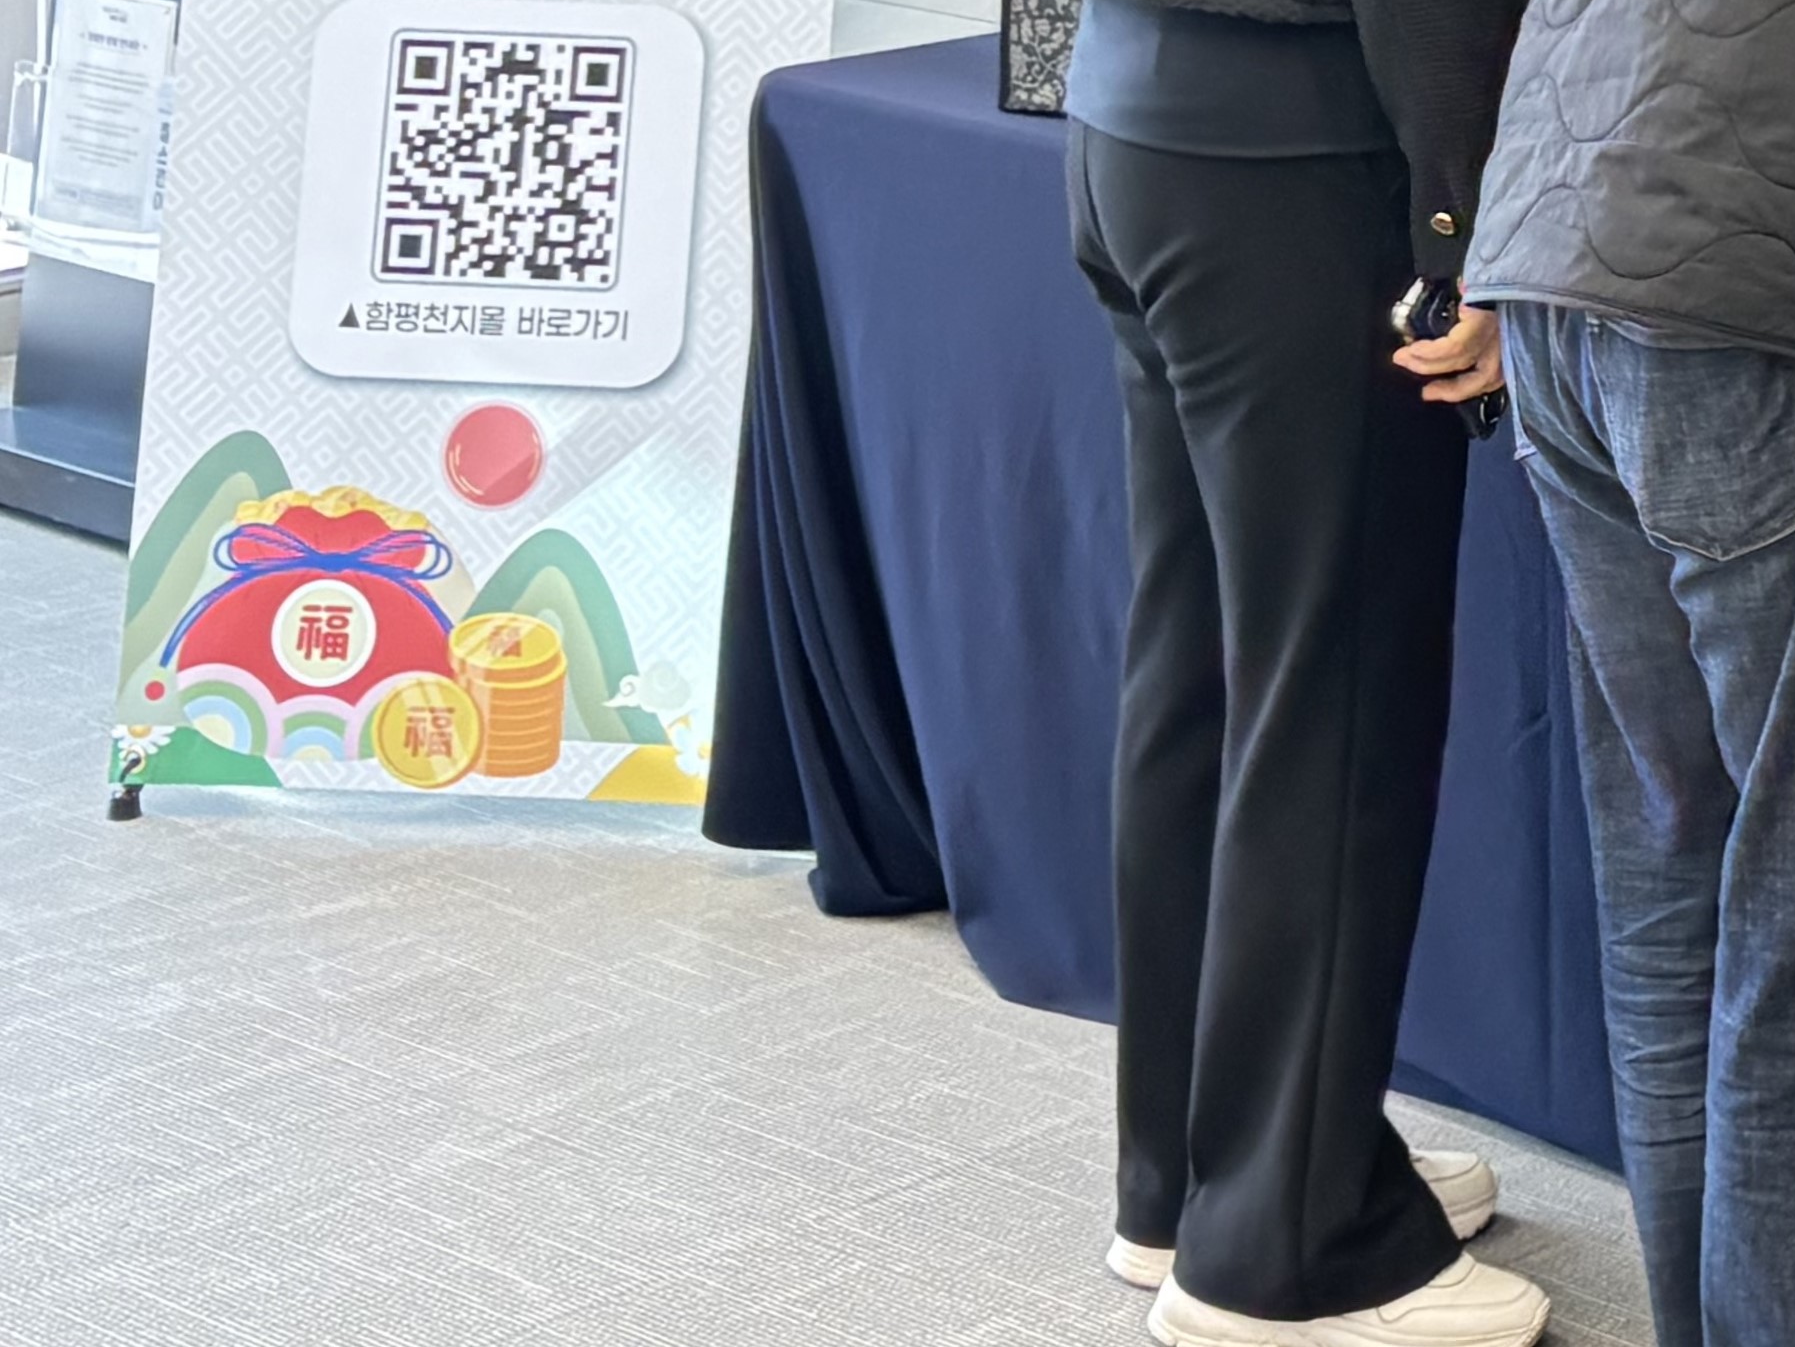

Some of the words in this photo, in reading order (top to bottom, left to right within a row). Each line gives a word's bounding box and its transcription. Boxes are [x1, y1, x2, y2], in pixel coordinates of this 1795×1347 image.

[365, 301, 506, 336] 함평천지몰
[516, 306, 631, 341] 바로가기
[296, 603, 353, 661] 福
[402, 706, 455, 759] 福
